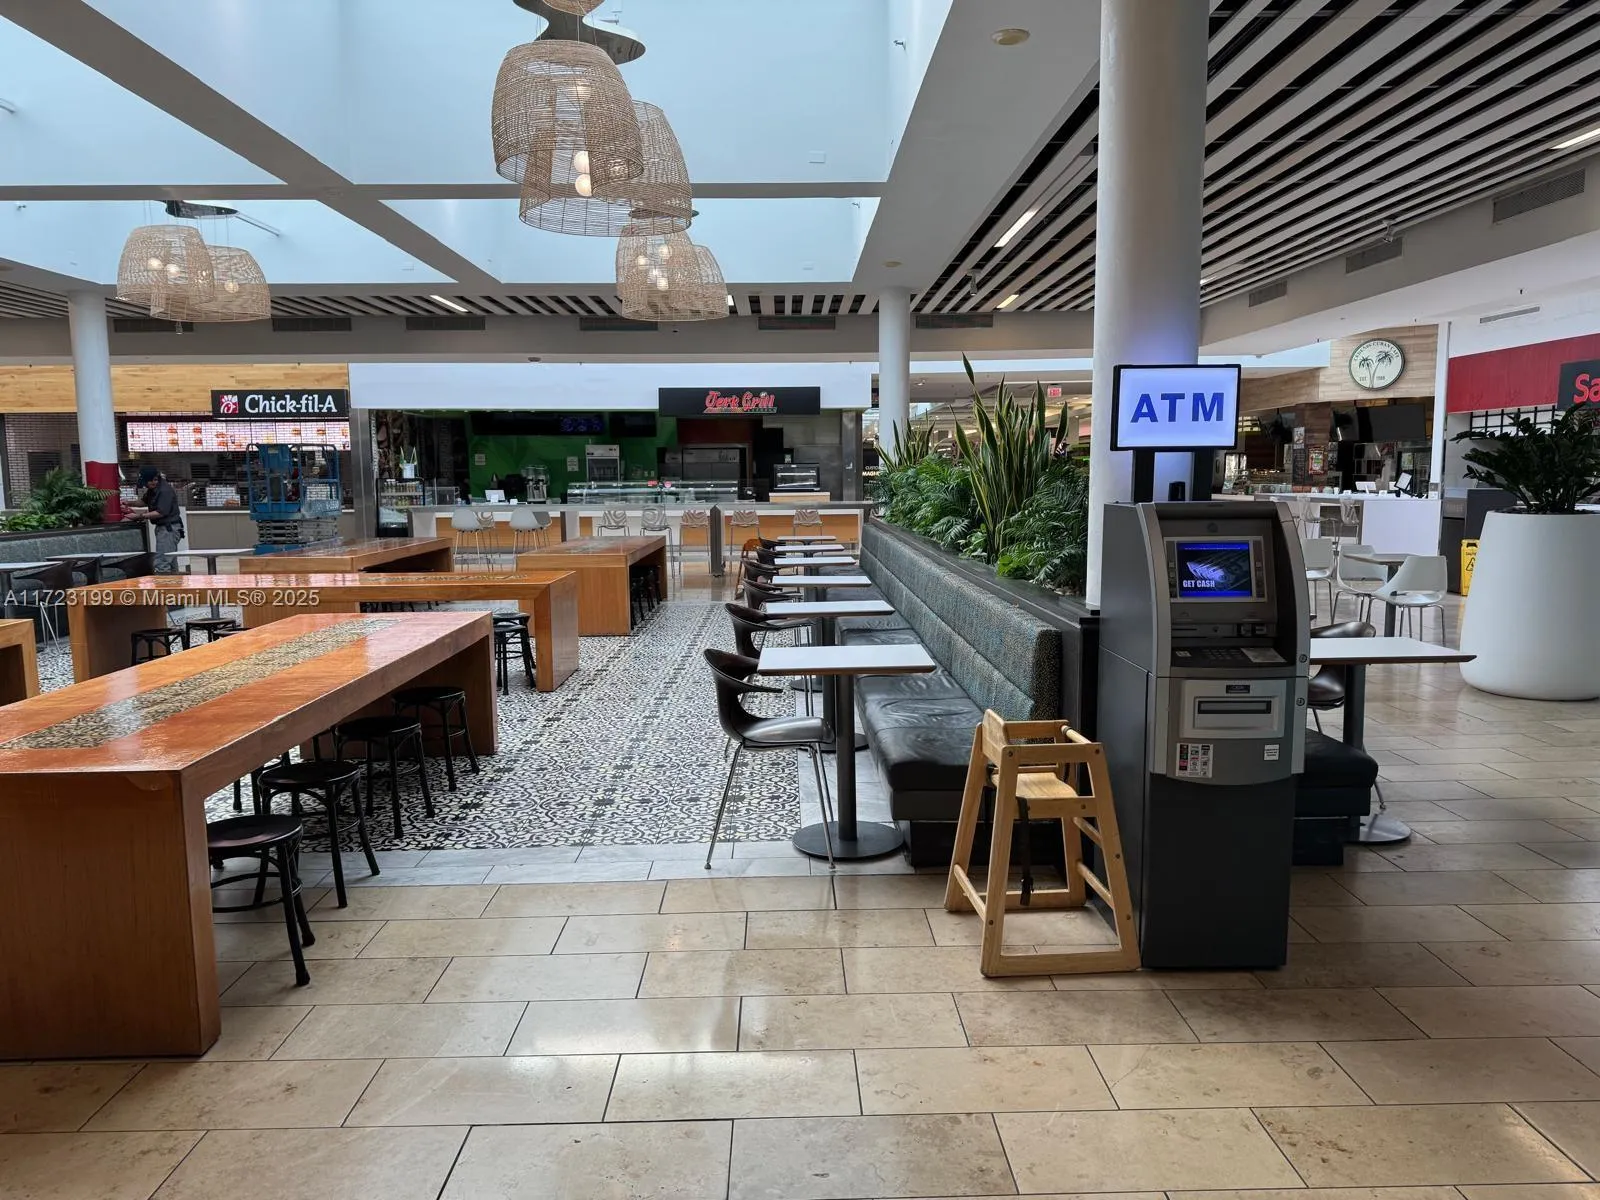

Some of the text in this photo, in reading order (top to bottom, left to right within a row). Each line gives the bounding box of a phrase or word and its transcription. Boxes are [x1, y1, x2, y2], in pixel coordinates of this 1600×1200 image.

[1574, 373, 1600, 403] Sa
[244, 394, 338, 414] Chick-fil-A
[705, 390, 775, 411] Jerk Grill
[1130, 392, 1225, 423] ATM
[1183, 580, 1215, 588] GET CASH
